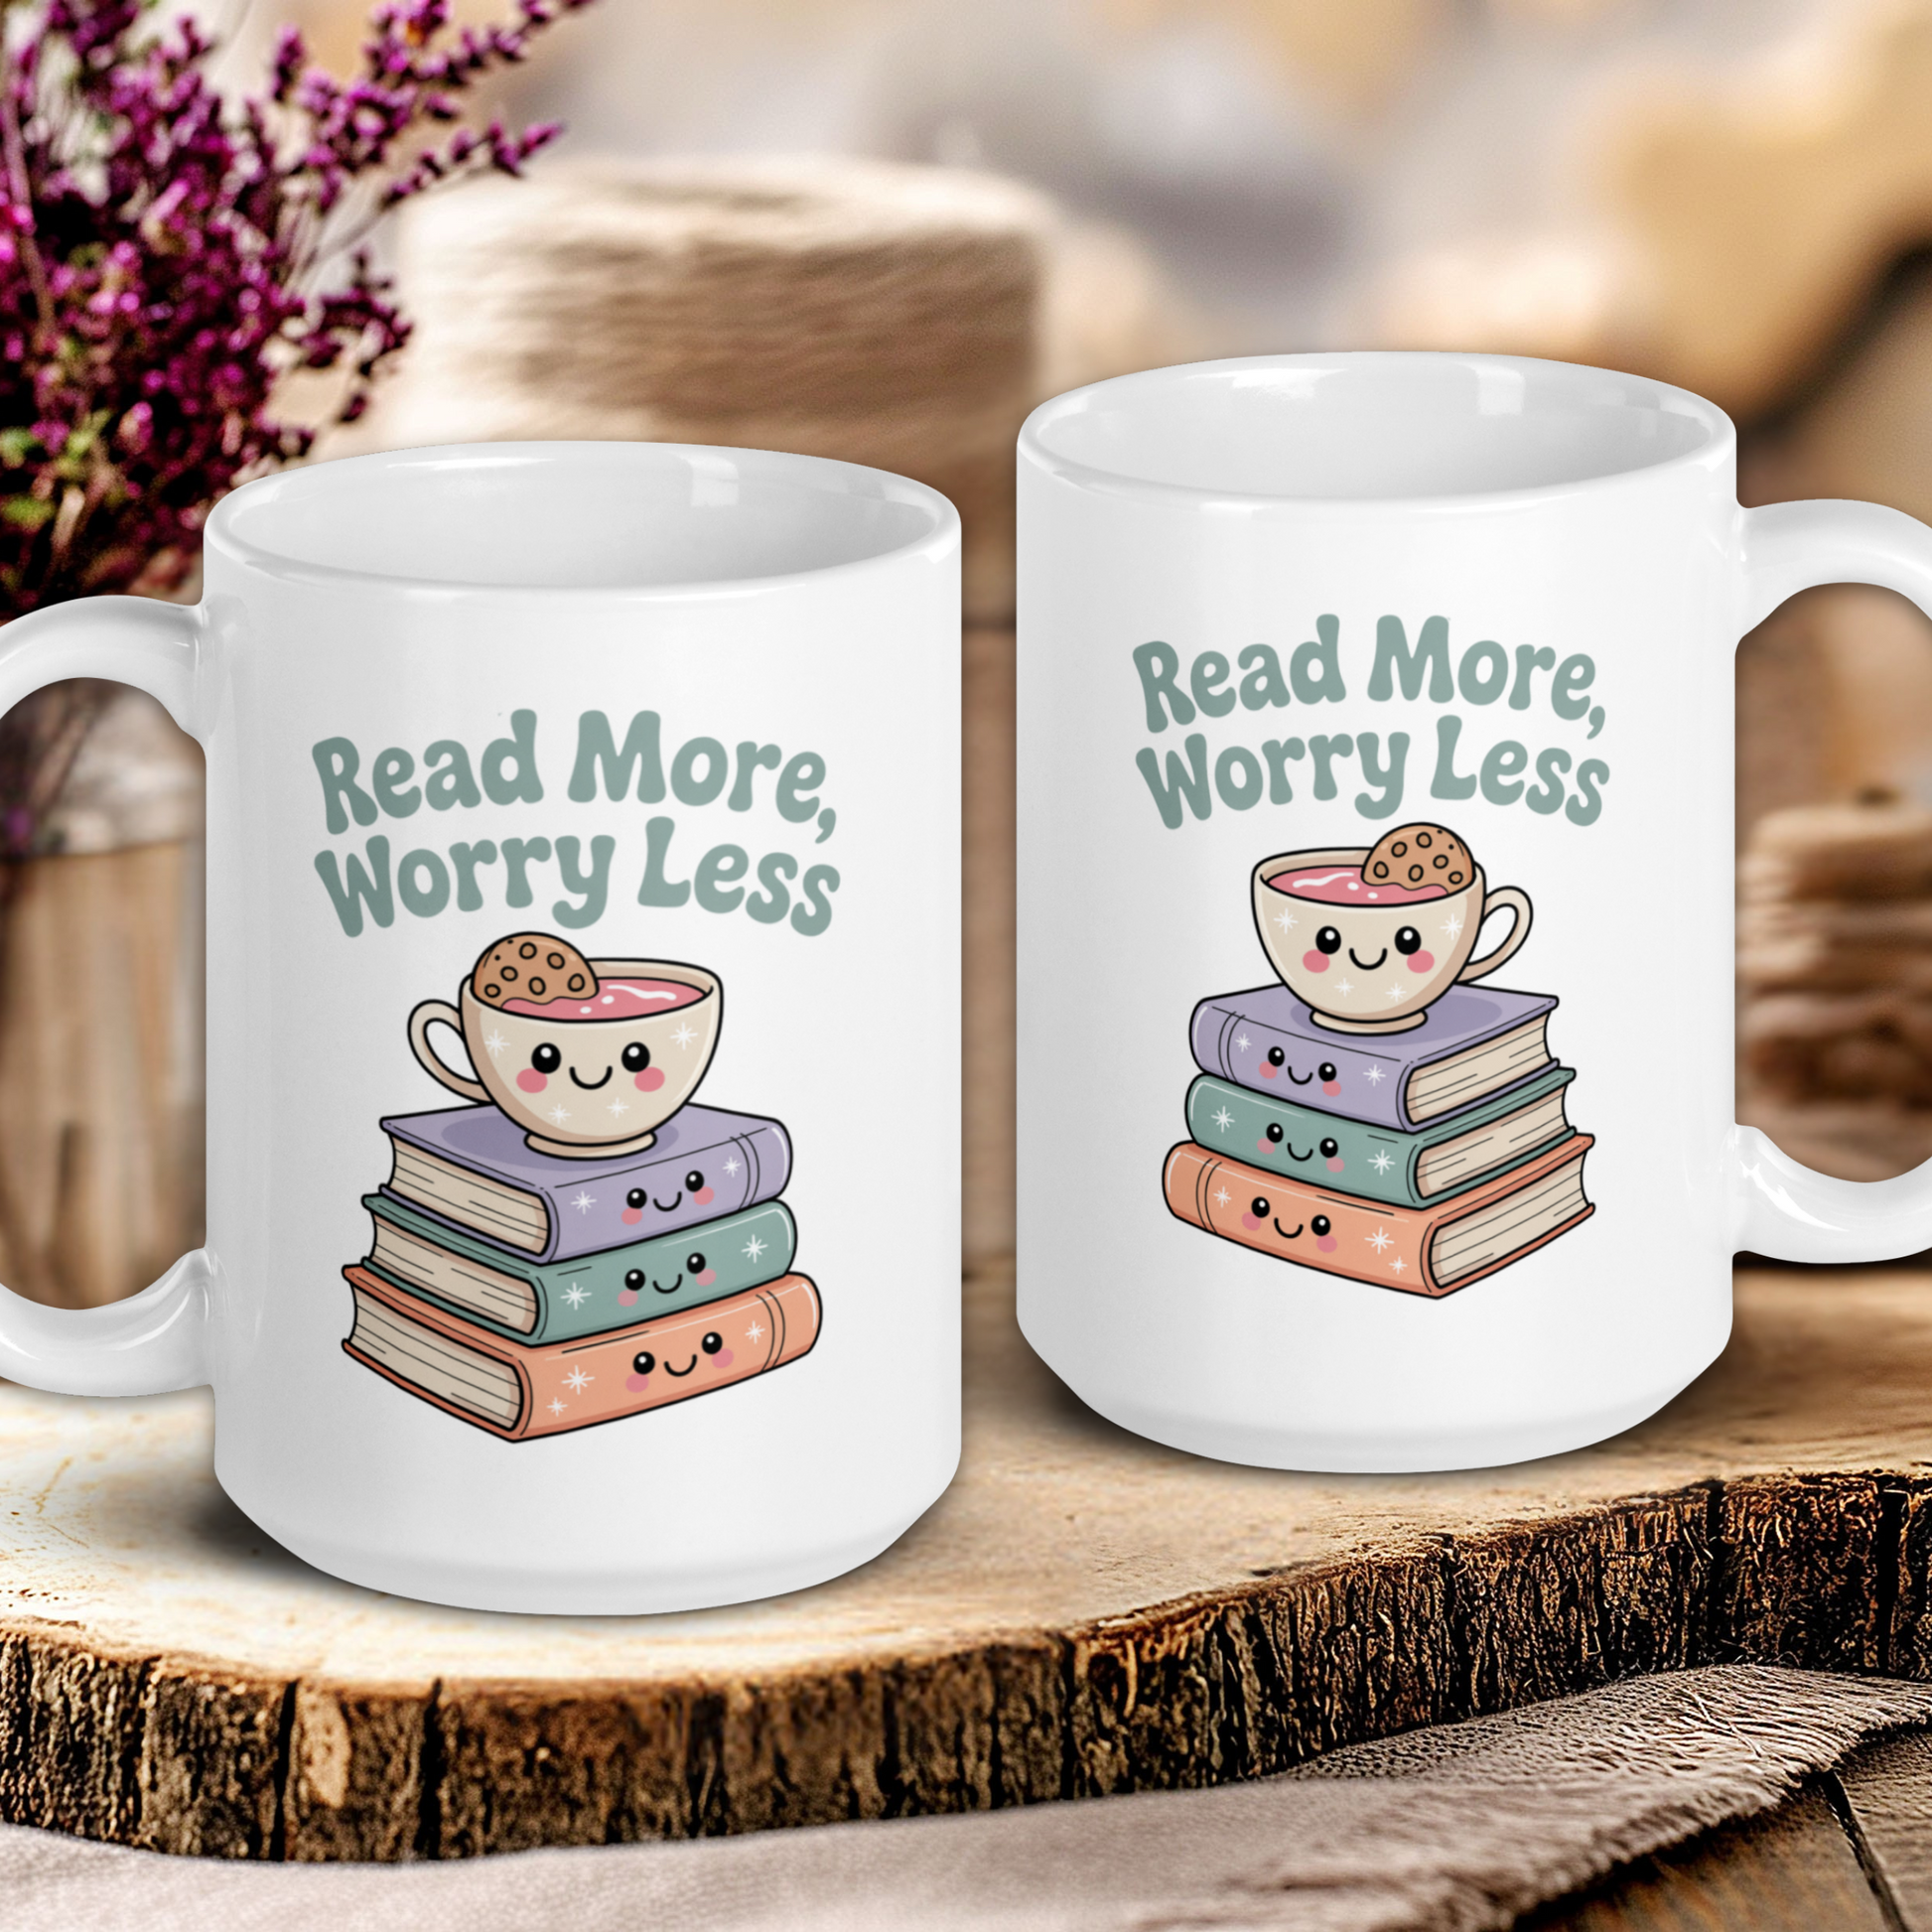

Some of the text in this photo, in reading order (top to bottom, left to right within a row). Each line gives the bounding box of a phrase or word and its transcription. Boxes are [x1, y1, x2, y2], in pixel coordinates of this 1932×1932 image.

[1132, 613, 1607, 740] Read More,
[312, 708, 838, 844] Read More,
[1135, 714, 1610, 830] Worry Less
[314, 815, 841, 938] Worry Less
